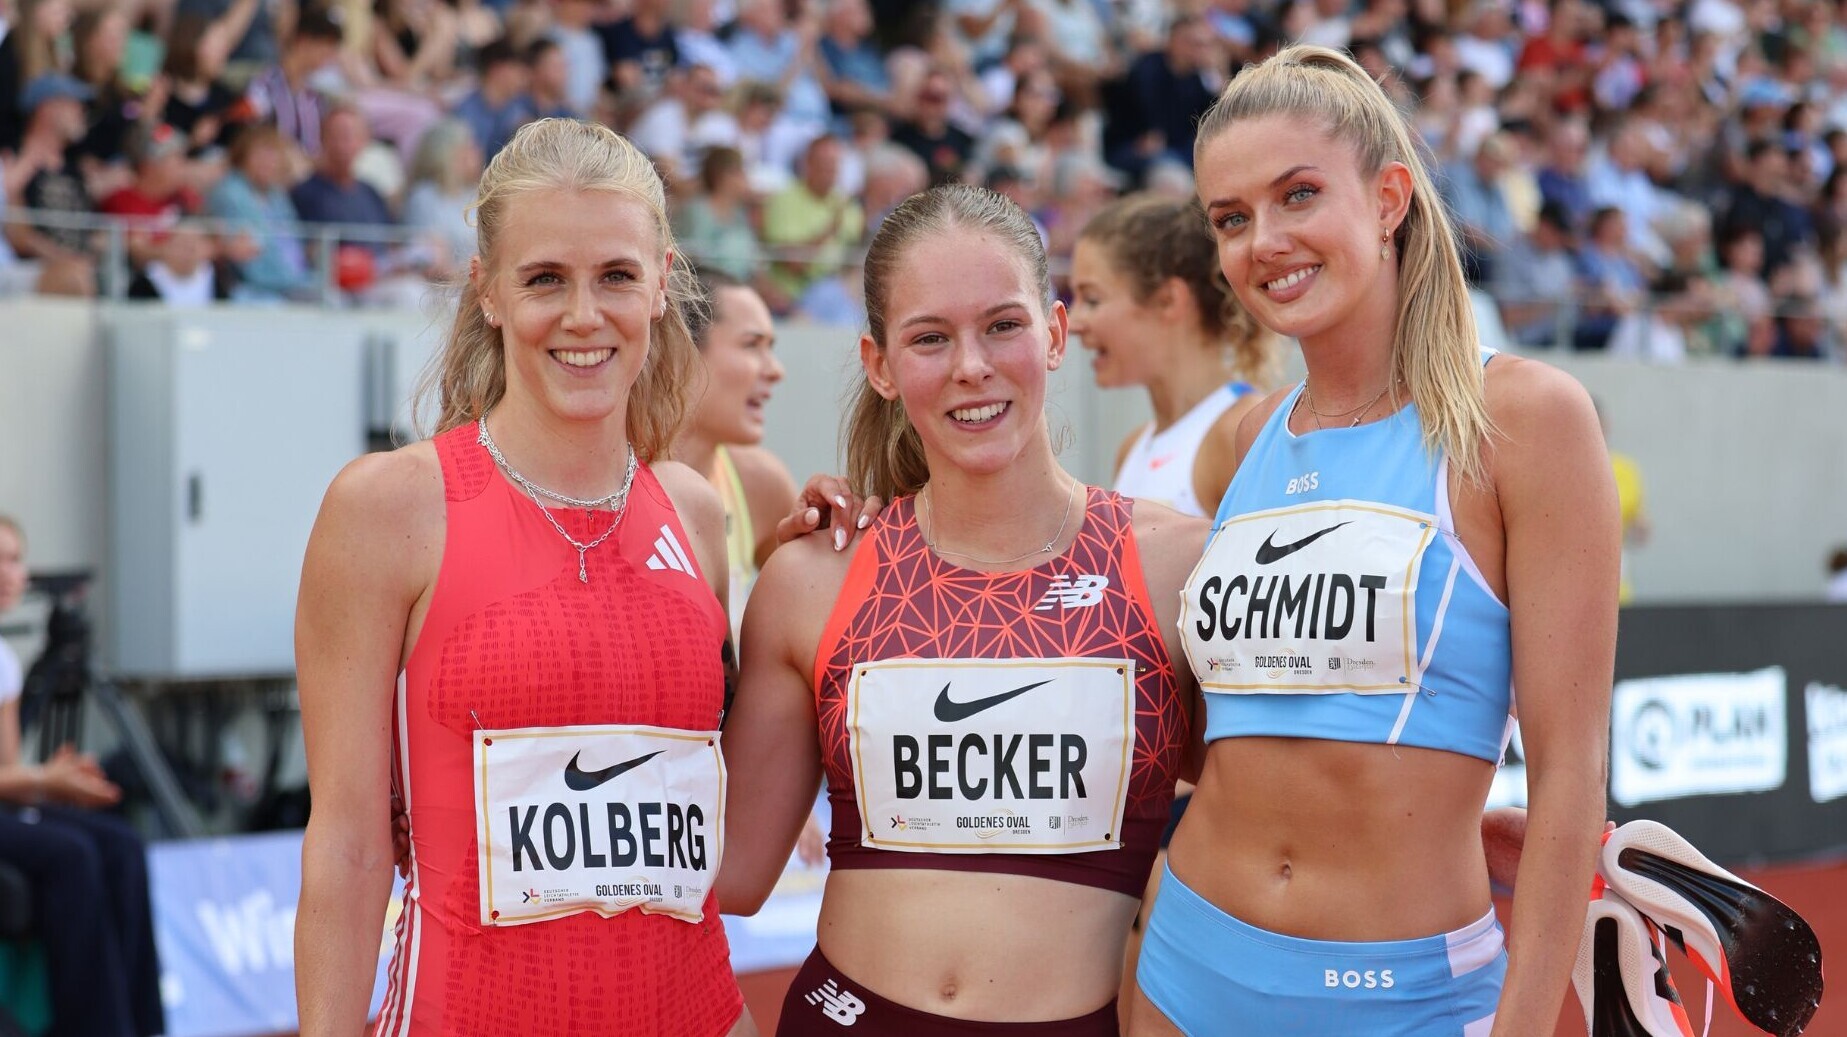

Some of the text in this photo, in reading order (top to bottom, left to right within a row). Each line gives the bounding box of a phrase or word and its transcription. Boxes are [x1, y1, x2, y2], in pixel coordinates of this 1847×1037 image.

[1285, 471, 1319, 495] BOSS
[1196, 573, 1388, 642] SCHMIDT
[1255, 655, 1287, 668] GOLDENES
[1289, 656, 1312, 668] OVAL
[893, 733, 1088, 801] BECKER
[956, 816, 1031, 828] GOLDENES OVAL
[508, 802, 707, 872] KOLBERG
[595, 884, 663, 897] GOLDENES OVAL
[1324, 969, 1395, 989] BOSS
